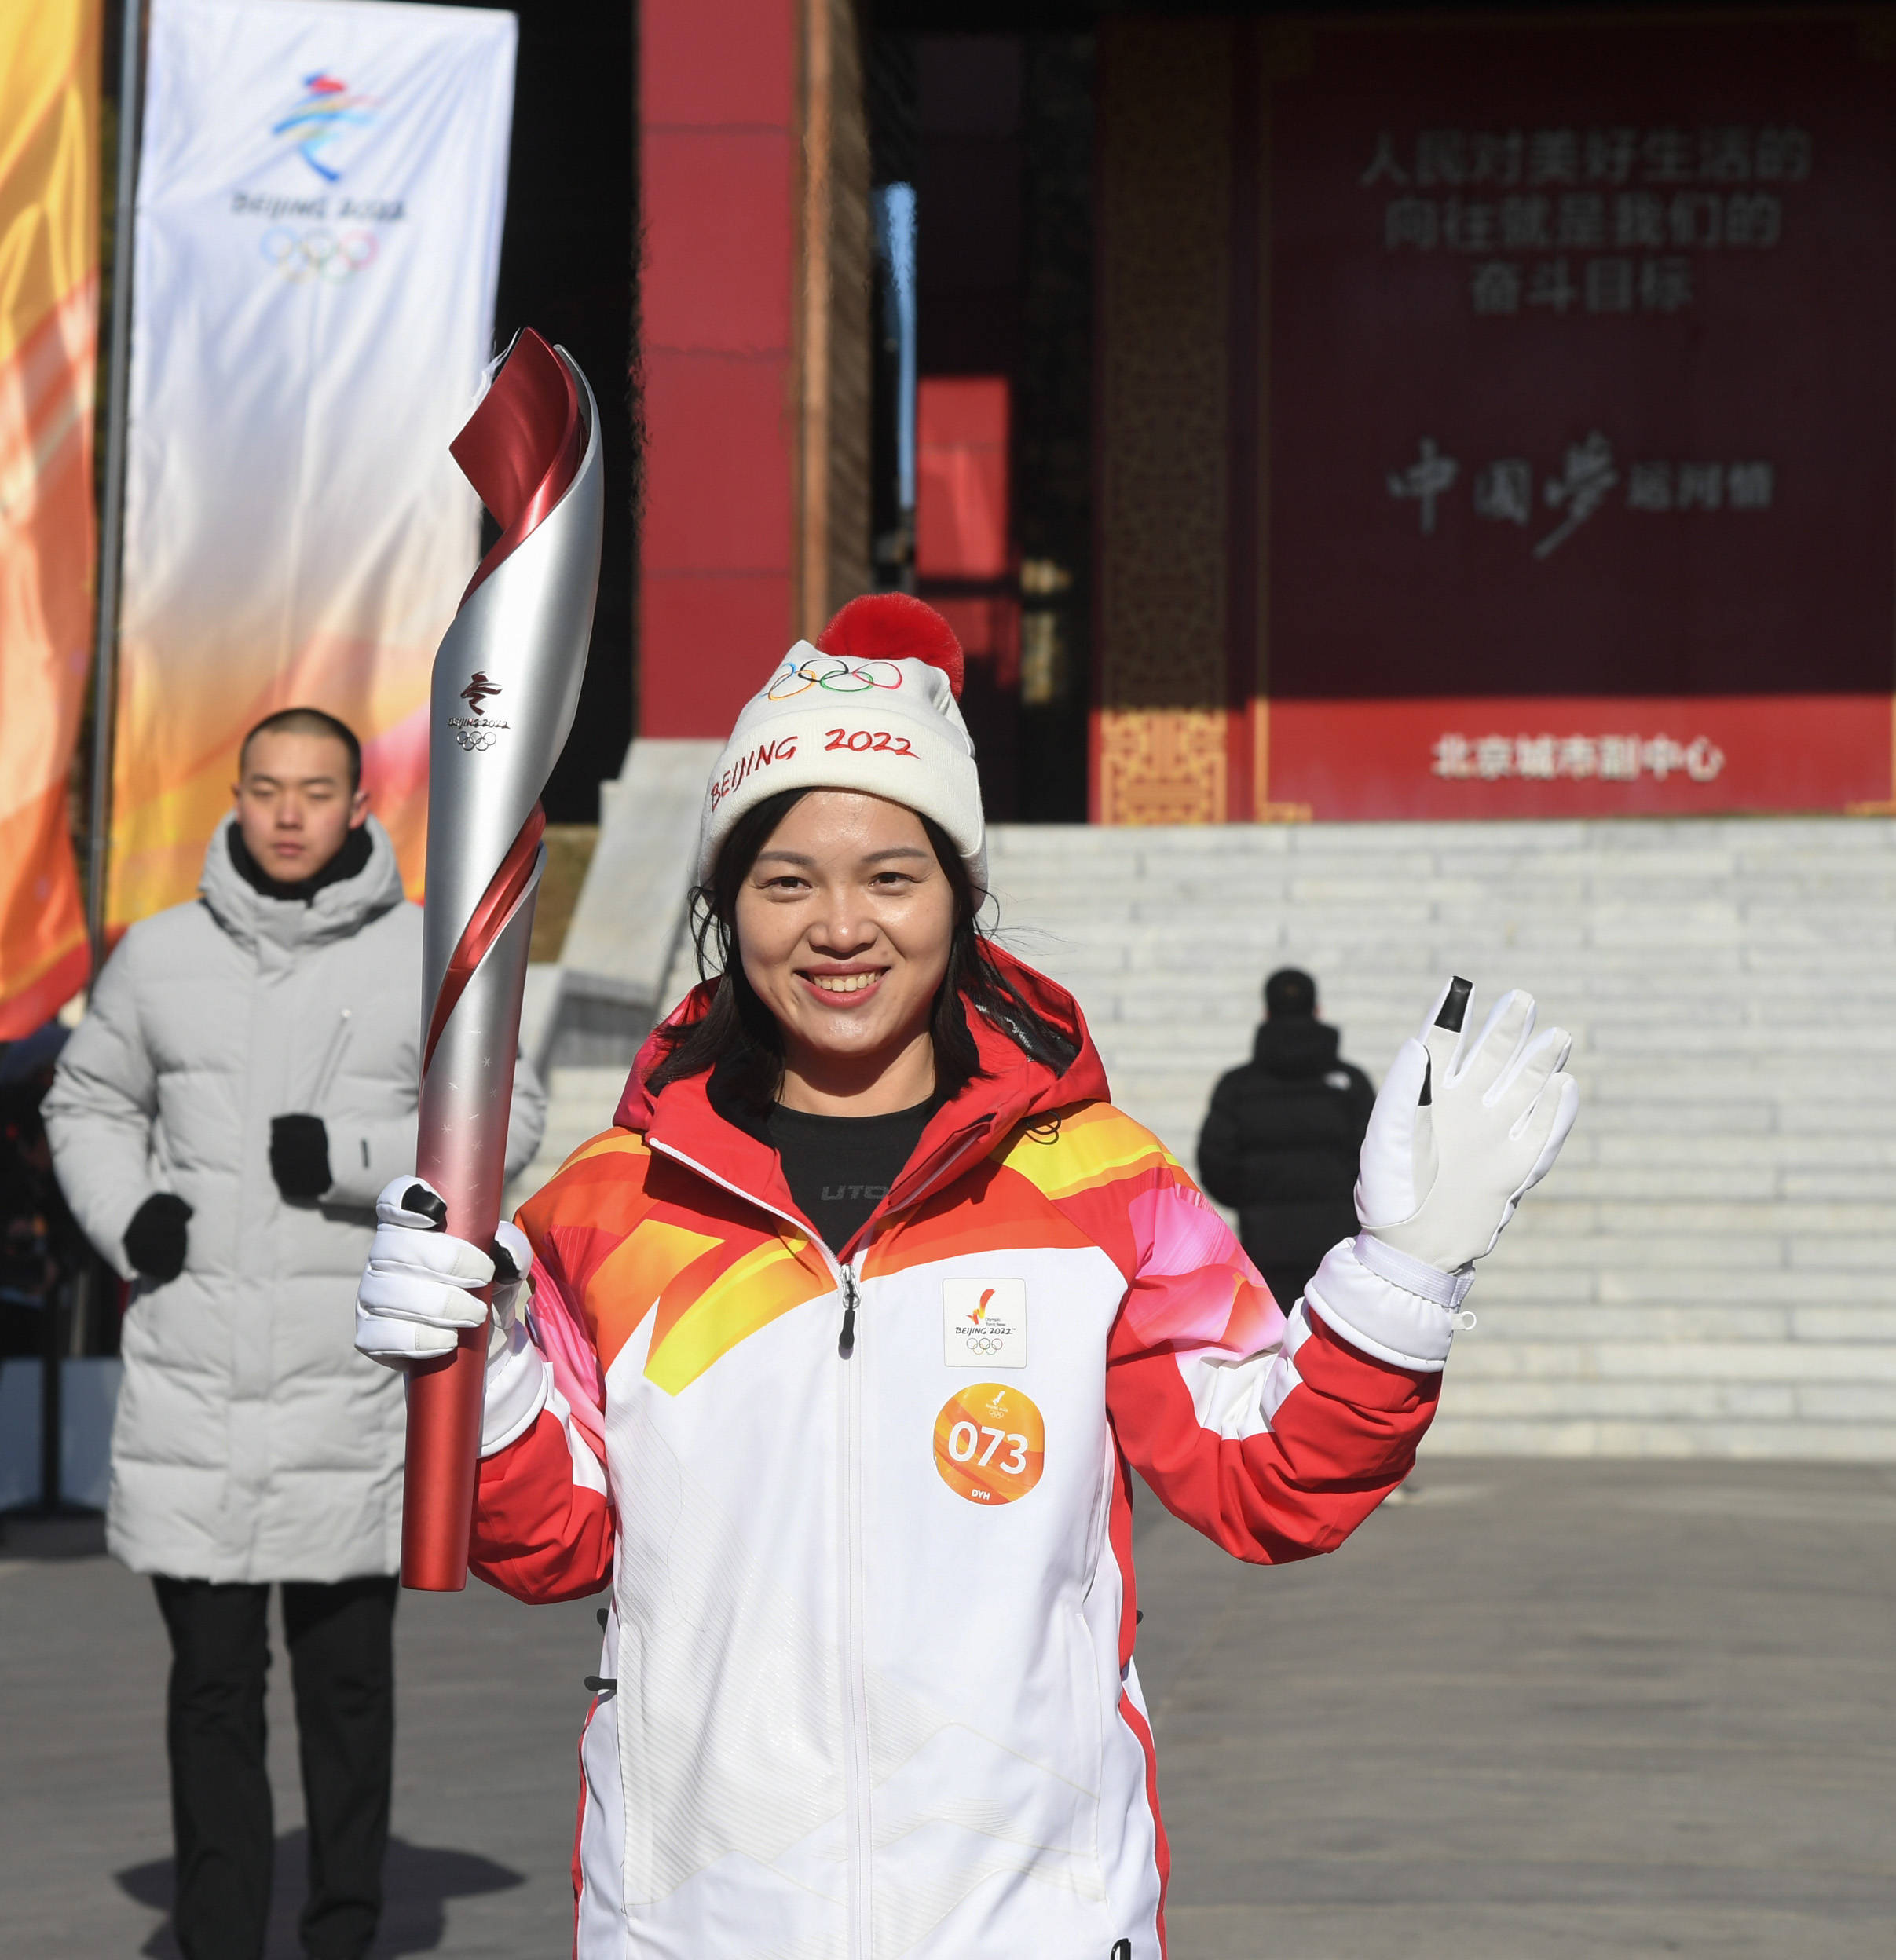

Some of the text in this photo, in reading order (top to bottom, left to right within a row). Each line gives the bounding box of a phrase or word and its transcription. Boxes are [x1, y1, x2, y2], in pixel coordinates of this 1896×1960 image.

[1358, 125, 1813, 188] 人民对美好生活的
[1383, 190, 1782, 251] 向往就是我们的
[1470, 257, 1694, 316] 奋斗目标
[711, 728, 921, 812] BEIJING 2022
[955, 1327, 986, 1336] BEIJING
[948, 1421, 1028, 1474] 073
[972, 1489, 990, 1500] DYH
